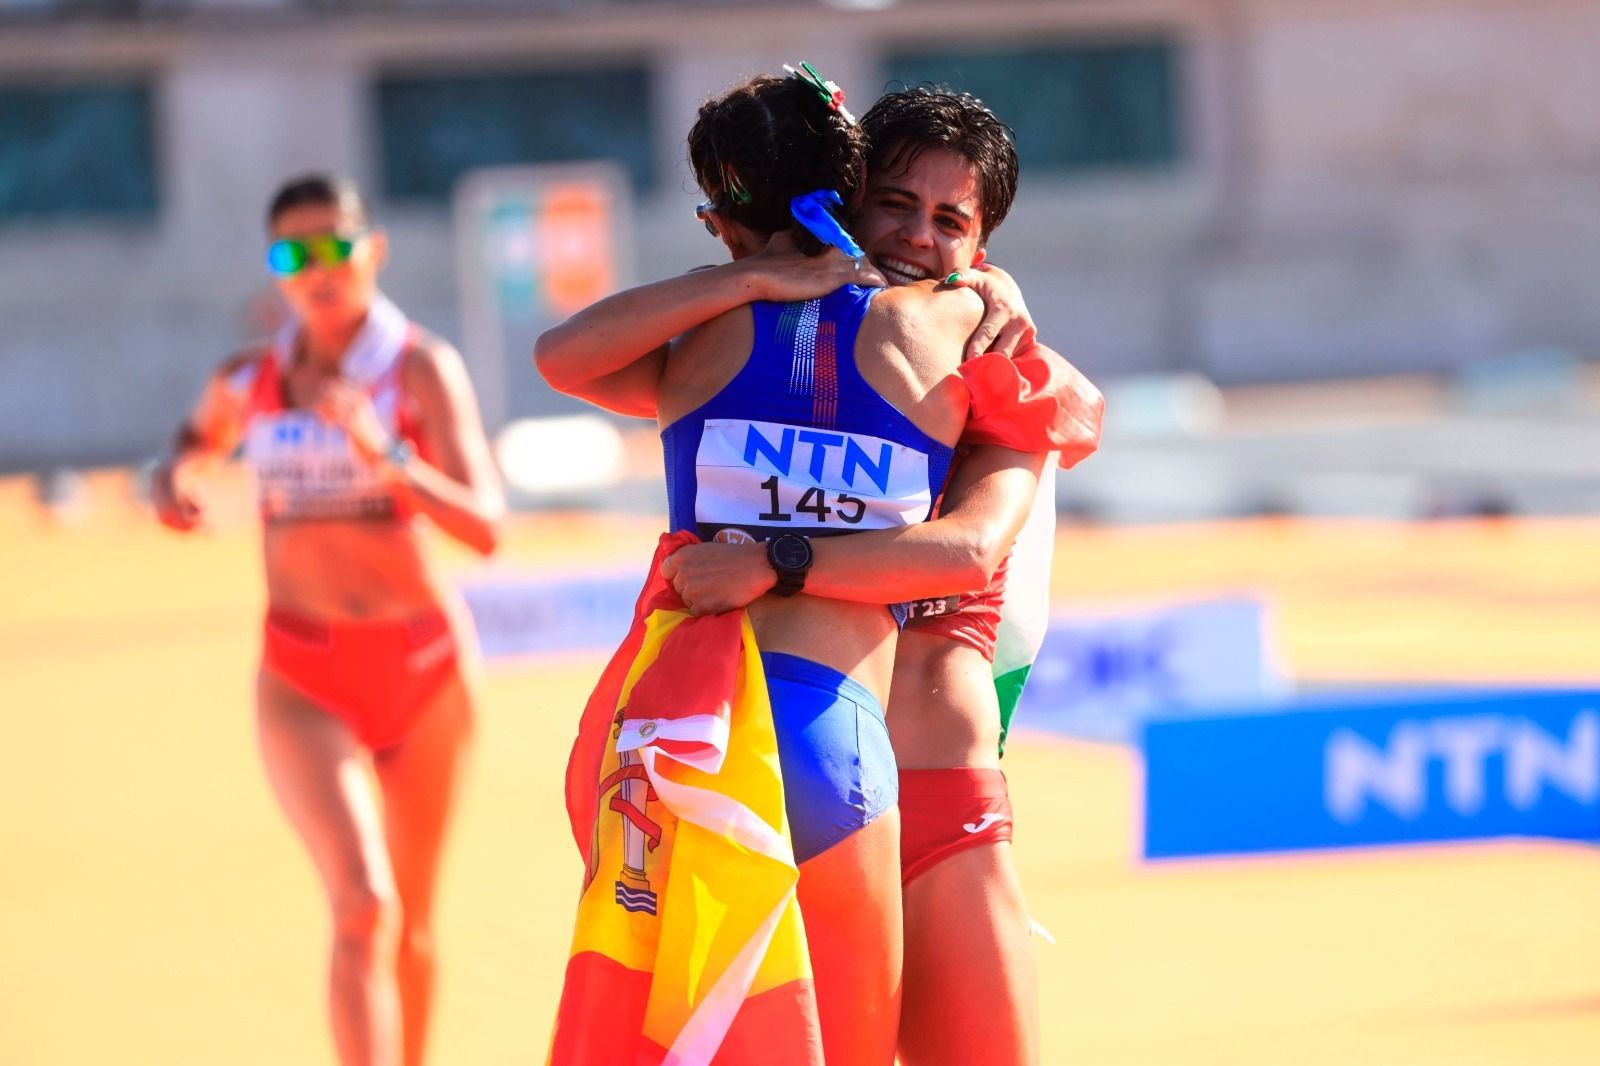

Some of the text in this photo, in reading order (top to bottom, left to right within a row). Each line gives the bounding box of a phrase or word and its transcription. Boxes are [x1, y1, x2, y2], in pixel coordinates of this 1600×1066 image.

[743, 423, 893, 495] NTN
[758, 475, 867, 524] 145
[921, 599, 947, 617] 23
[1326, 711, 1600, 823] NTN
